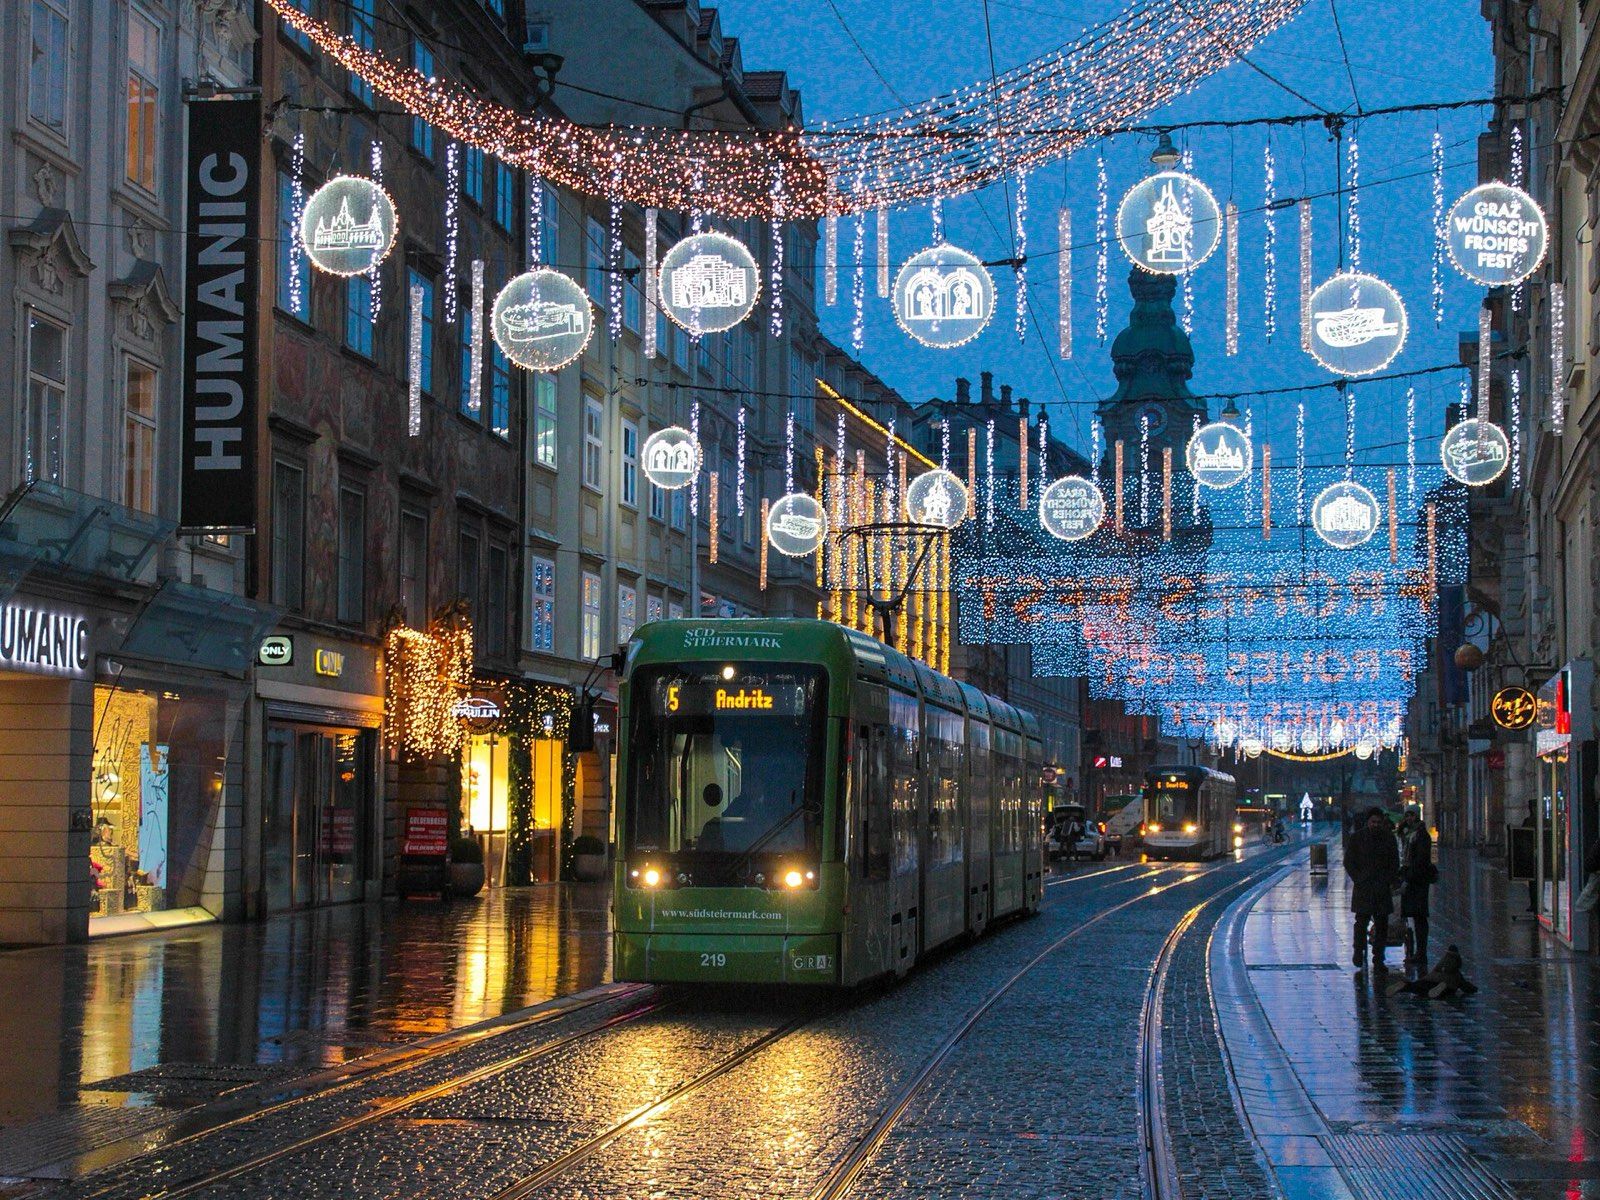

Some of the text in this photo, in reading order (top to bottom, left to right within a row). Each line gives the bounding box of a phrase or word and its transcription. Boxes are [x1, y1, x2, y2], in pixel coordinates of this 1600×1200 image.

[1474, 201, 1521, 218] GRAZ
[1454, 215, 1539, 236] WÜNSCHT
[1464, 235, 1528, 253] FROHES
[1477, 253, 1514, 268] FEST
[194, 152, 248, 470] HUMANIC
[686, 628, 715, 637] SÜD
[683, 637, 781, 648] STEIERMARK
[261, 646, 290, 656] ONLY
[668, 687, 773, 711] 5 Andritz
[661, 908, 783, 920] www.südsteiermark.com
[700, 953, 726, 967] 219
[793, 955, 833, 970] GRAZ
